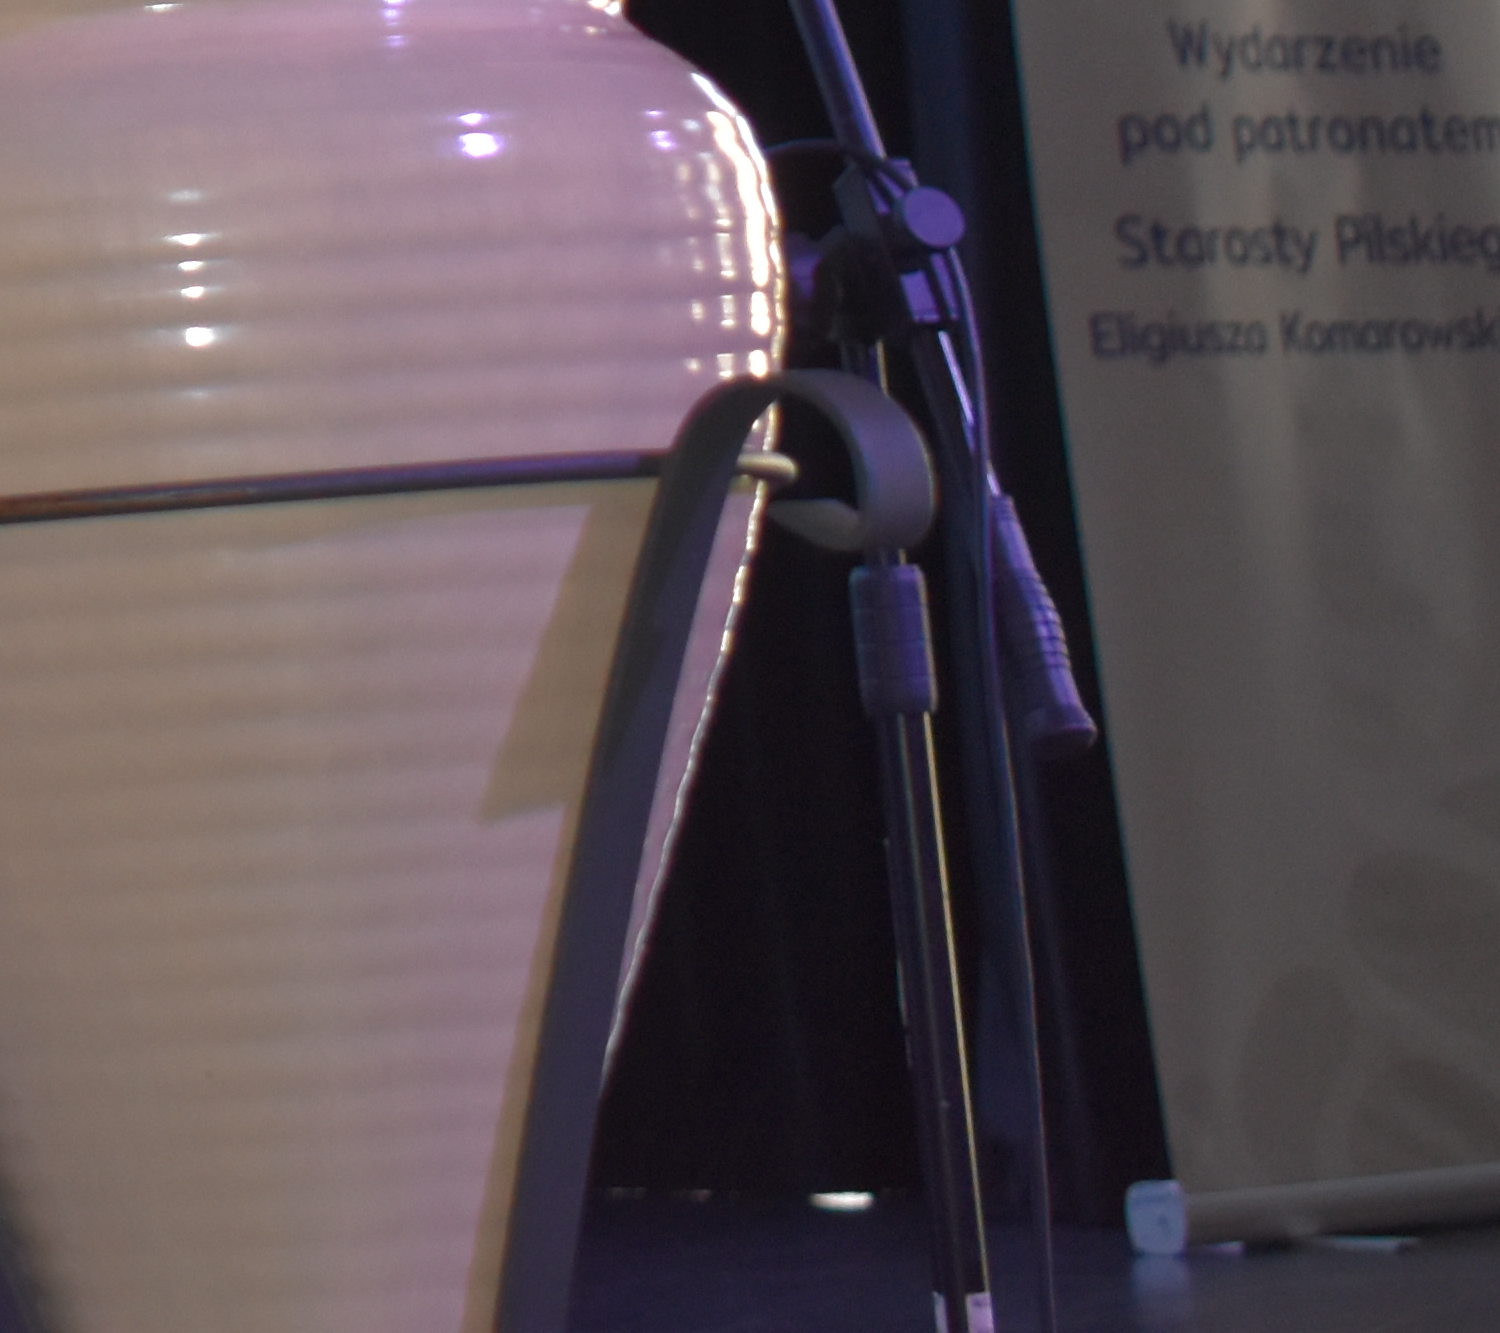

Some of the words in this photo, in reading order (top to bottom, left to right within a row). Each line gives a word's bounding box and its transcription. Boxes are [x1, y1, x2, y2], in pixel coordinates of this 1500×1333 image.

[1167, 17, 1443, 82] Wydarzenie
[1118, 103, 1213, 166] pod
[1113, 212, 1318, 277] Starosty
[1089, 309, 1269, 365] Eligiusza
